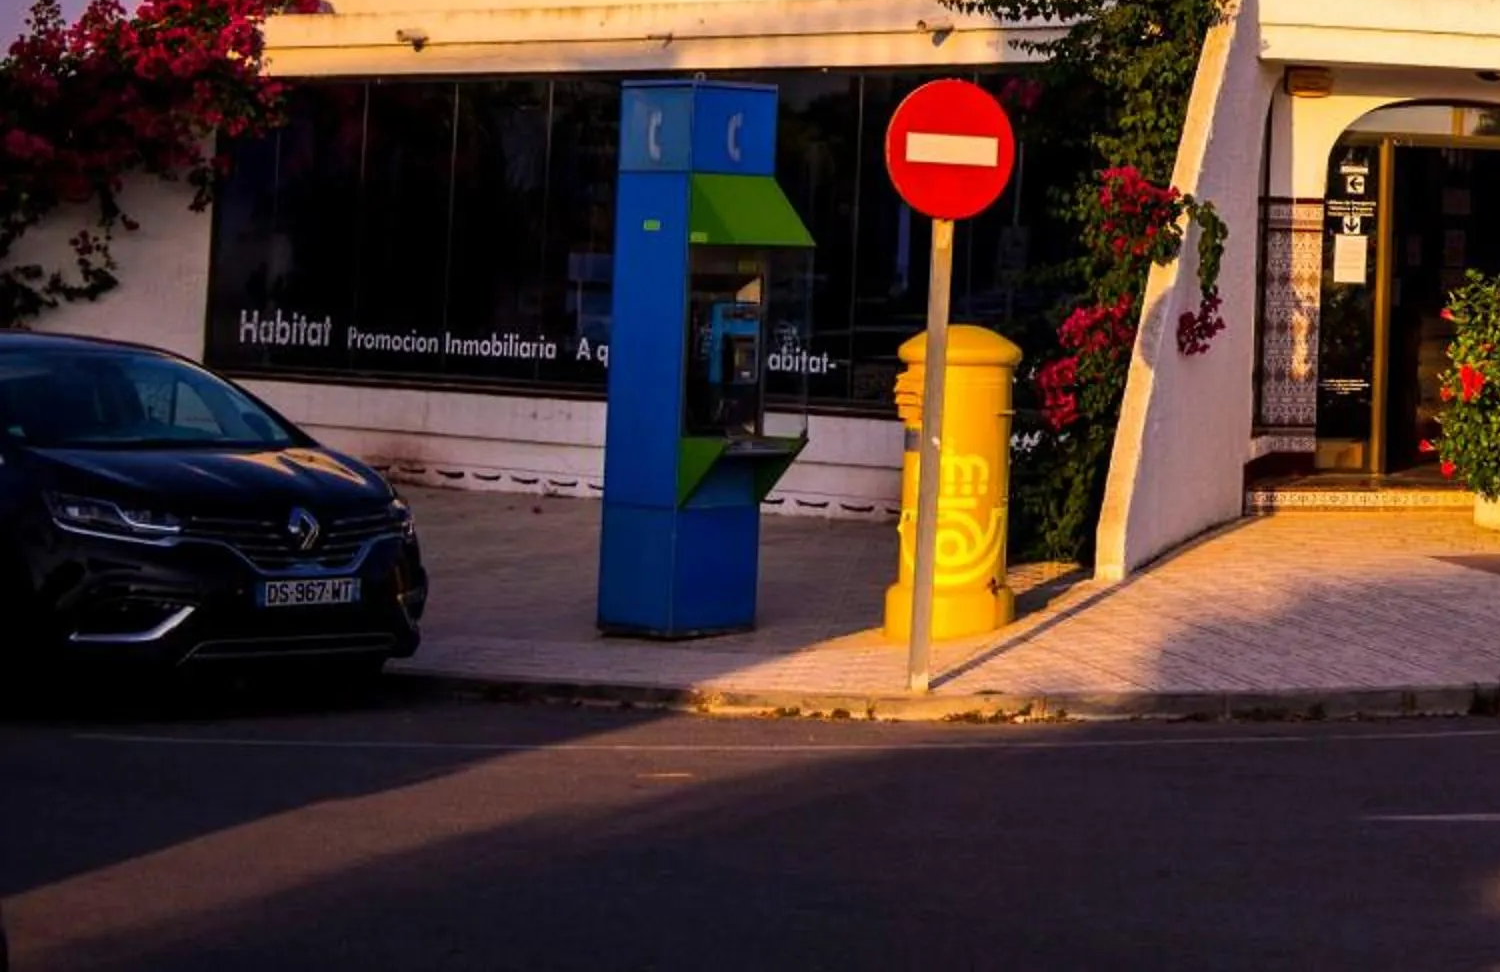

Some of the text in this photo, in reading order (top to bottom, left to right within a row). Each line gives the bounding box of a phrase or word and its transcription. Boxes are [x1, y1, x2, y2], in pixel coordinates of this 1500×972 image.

[239, 308, 332, 347] Habitat
[347, 326, 439, 354] Promocion
[445, 331, 557, 360] Inmobiliaria
[767, 345, 837, 374] abitat-
